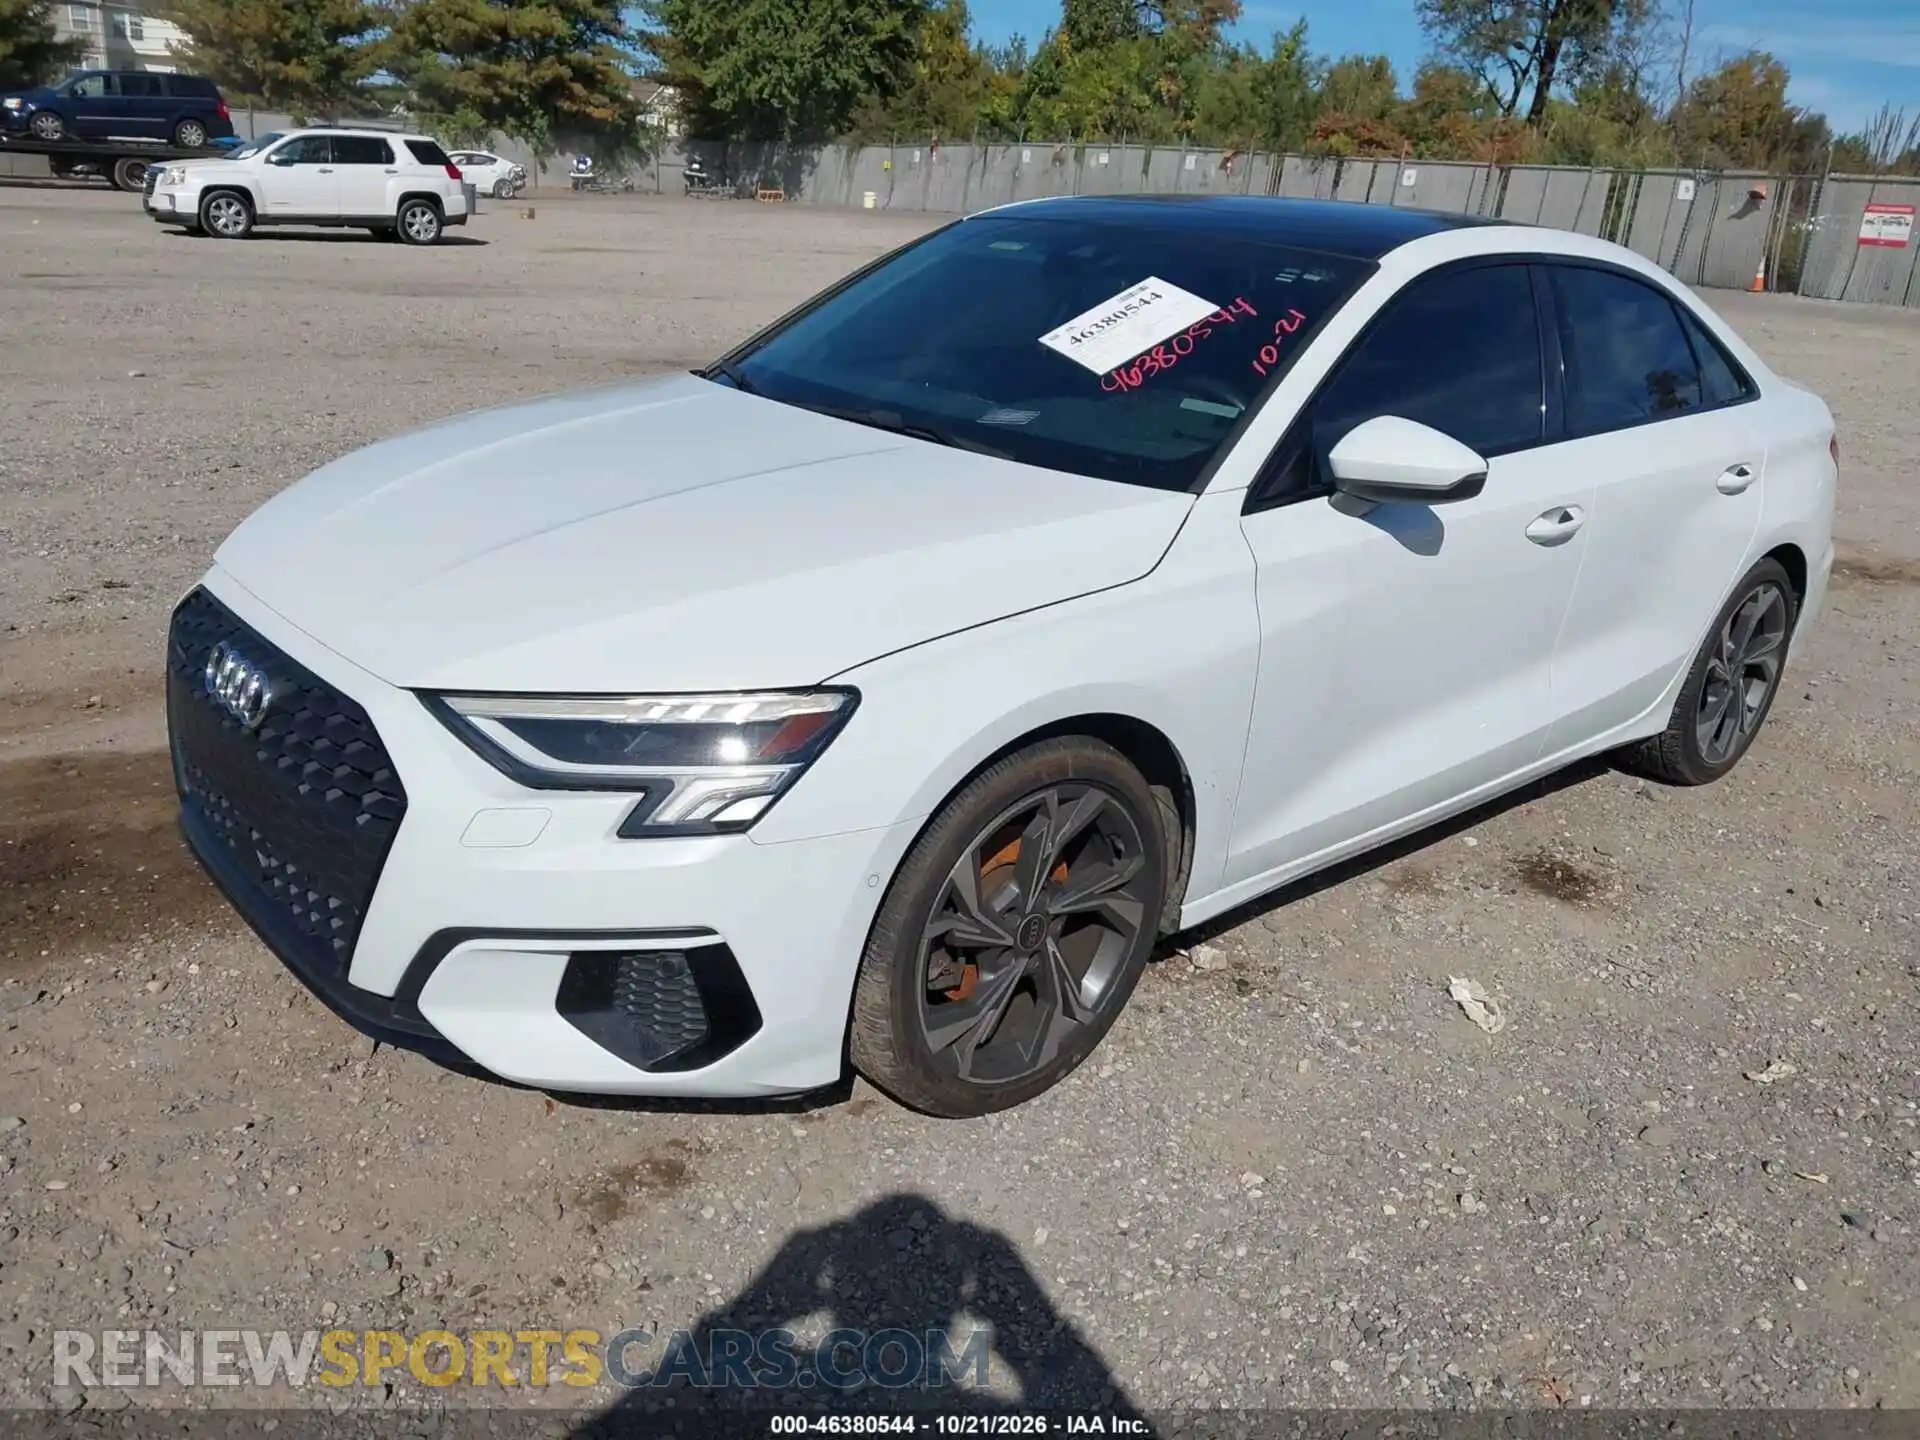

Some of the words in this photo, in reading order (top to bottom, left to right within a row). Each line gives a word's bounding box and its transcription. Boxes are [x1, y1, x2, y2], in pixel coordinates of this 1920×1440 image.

[1069, 291, 1164, 346] 46380544
[1100, 297, 1257, 392] 46380544
[1252, 308, 1307, 375] 10-21
